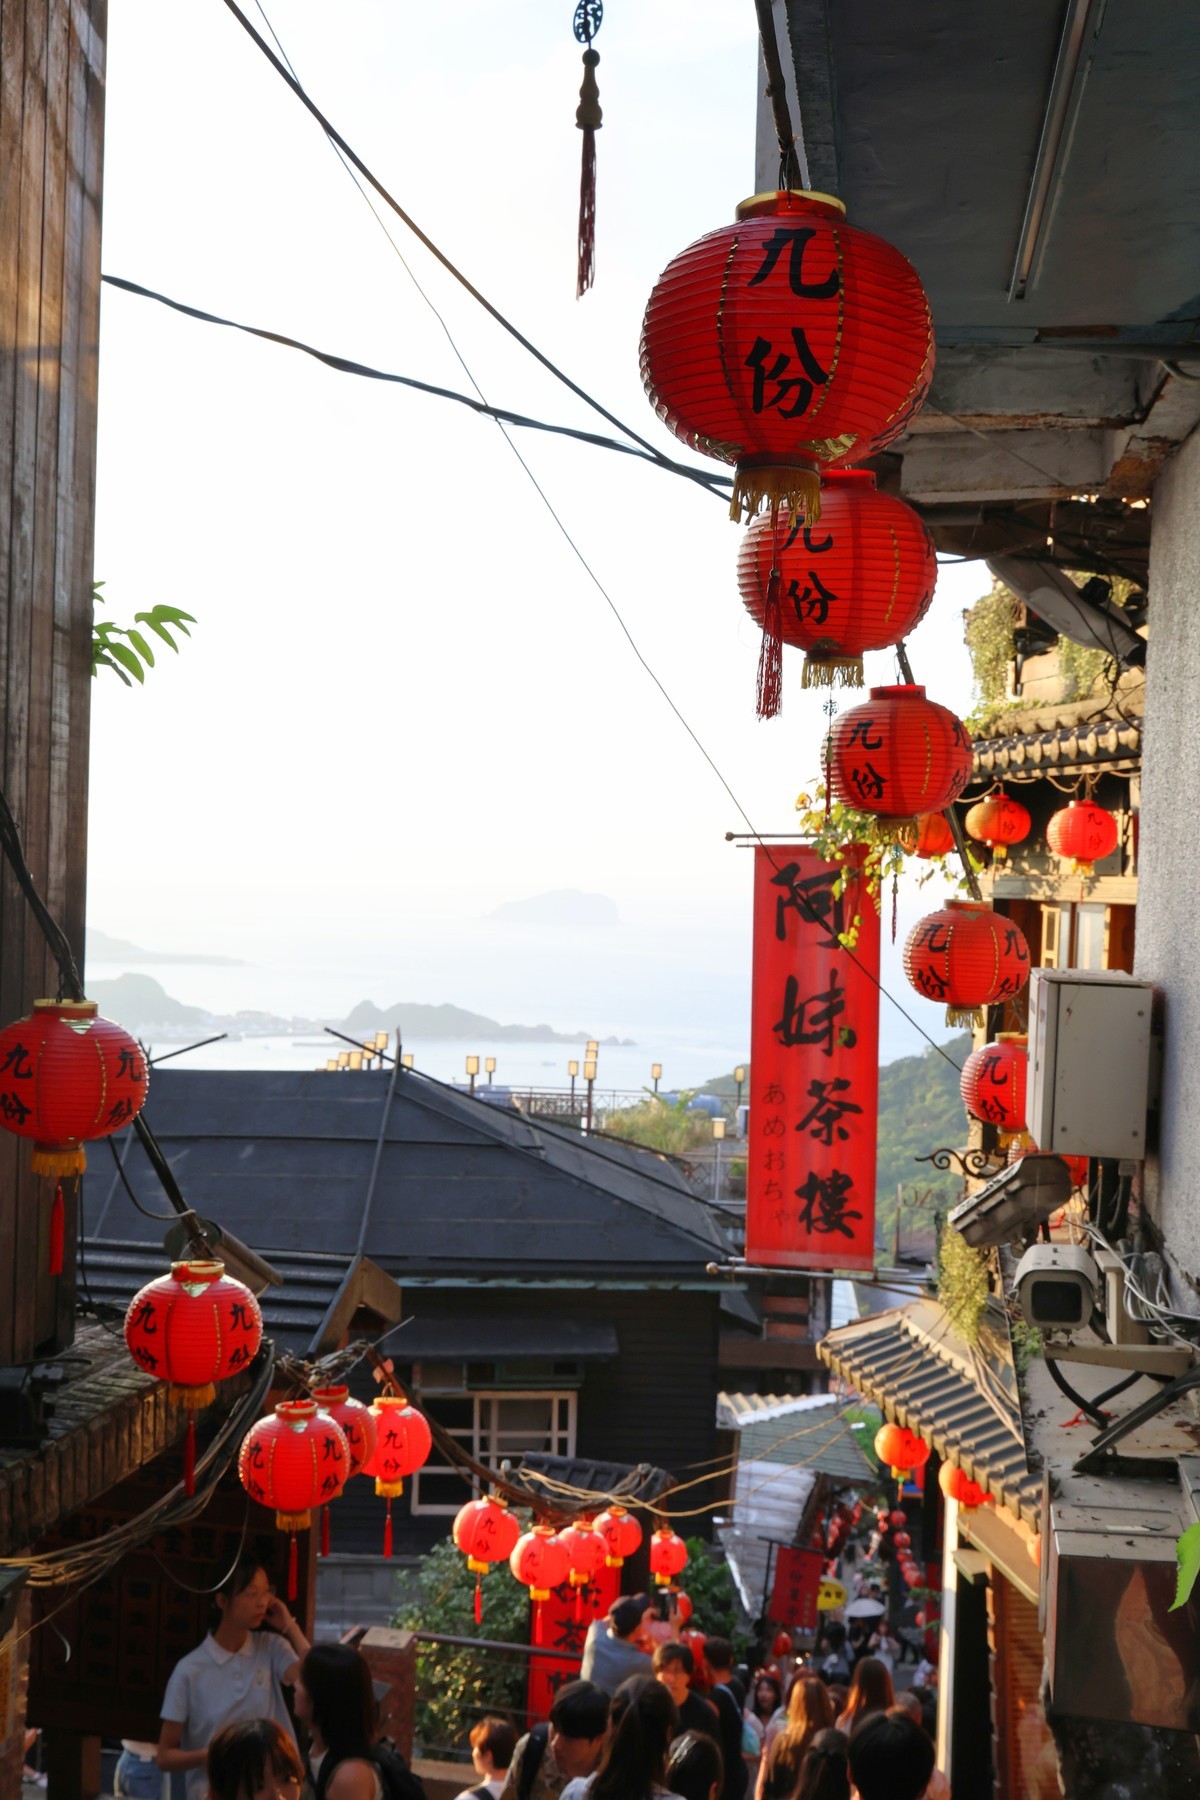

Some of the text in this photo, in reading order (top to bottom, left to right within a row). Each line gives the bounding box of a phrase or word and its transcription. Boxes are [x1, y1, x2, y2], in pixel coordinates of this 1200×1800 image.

[745, 227, 839, 419] 九份
[782, 515, 839, 625] 九份
[847, 720, 888, 799] 九份
[1002, 804, 1016, 835] 九份
[1088, 812, 1103, 848] 九份
[917, 923, 949, 998] 九份
[0, 1043, 33, 1126] 九份
[104, 1047, 142, 1127] 九份
[769, 862, 863, 1239] 阿妹茶樓
[980, 1056, 1010, 1122] 九份
[763, 1083, 790, 1227] あめおちゃ
[132, 1301, 160, 1372] 九份
[228, 1303, 254, 1371] 九份
[321, 1436, 342, 1496] 九份
[383, 1429, 403, 1472] 九份
